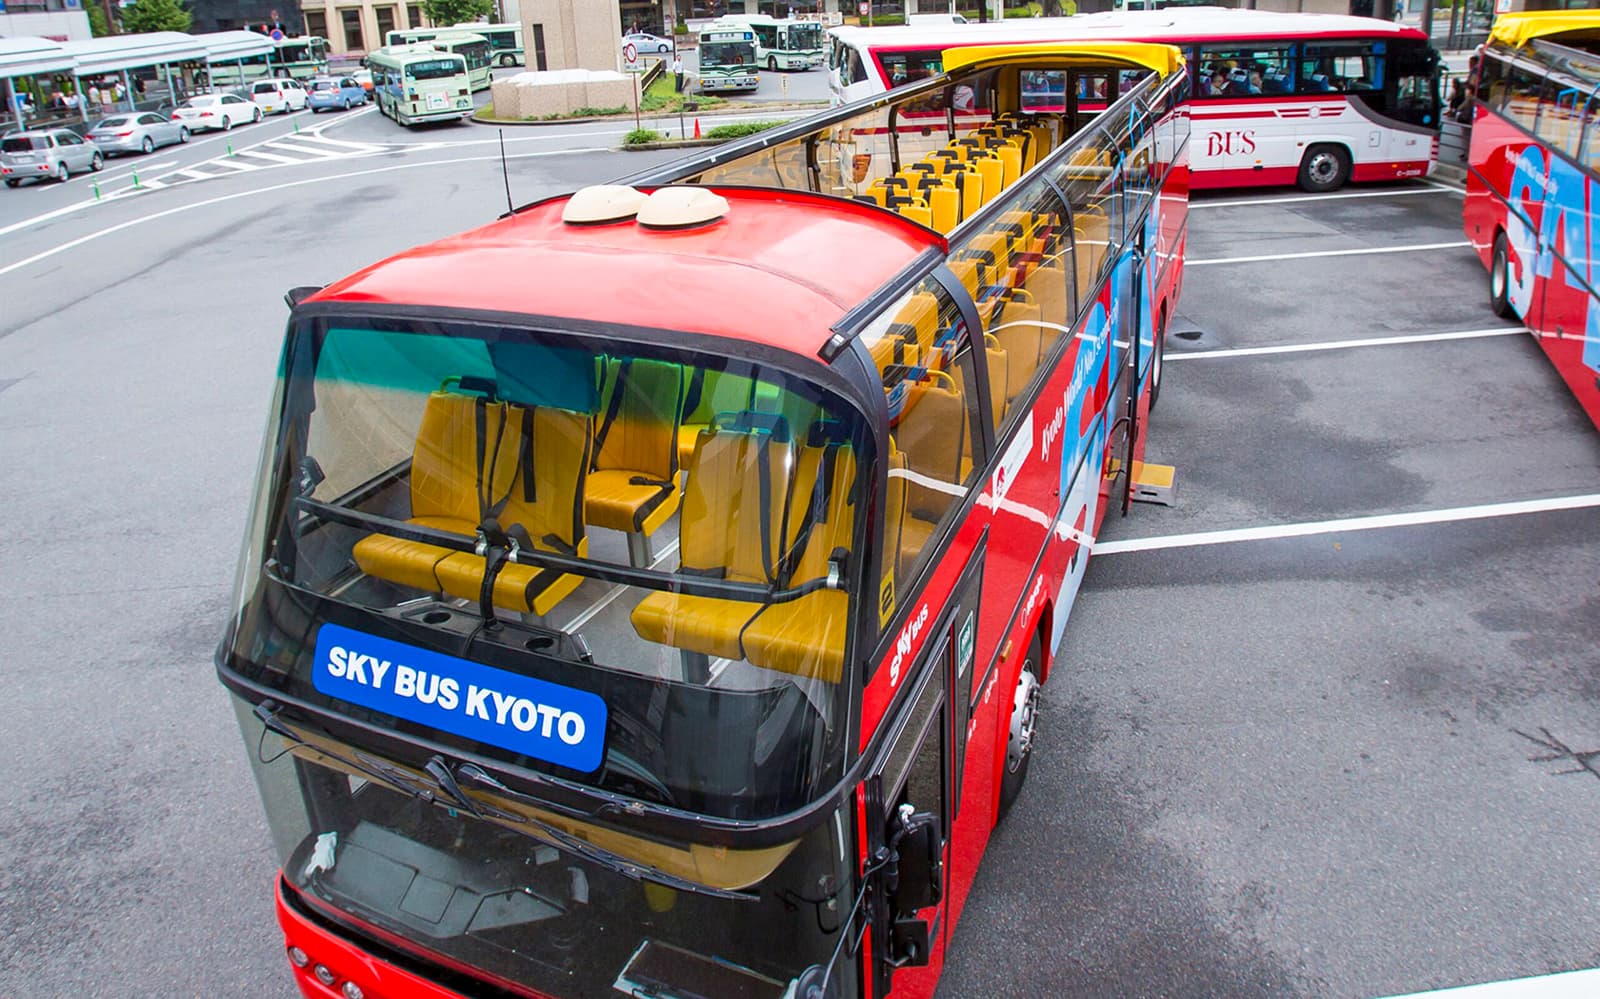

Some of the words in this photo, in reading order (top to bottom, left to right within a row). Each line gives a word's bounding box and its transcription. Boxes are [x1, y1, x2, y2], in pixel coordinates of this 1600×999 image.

[1206, 130, 1256, 157] BUS
[1041, 406, 1063, 463] Kyoto
[327, 646, 391, 689] SKY
[394, 665, 459, 710] BUS
[465, 685, 586, 746] KYOTO
